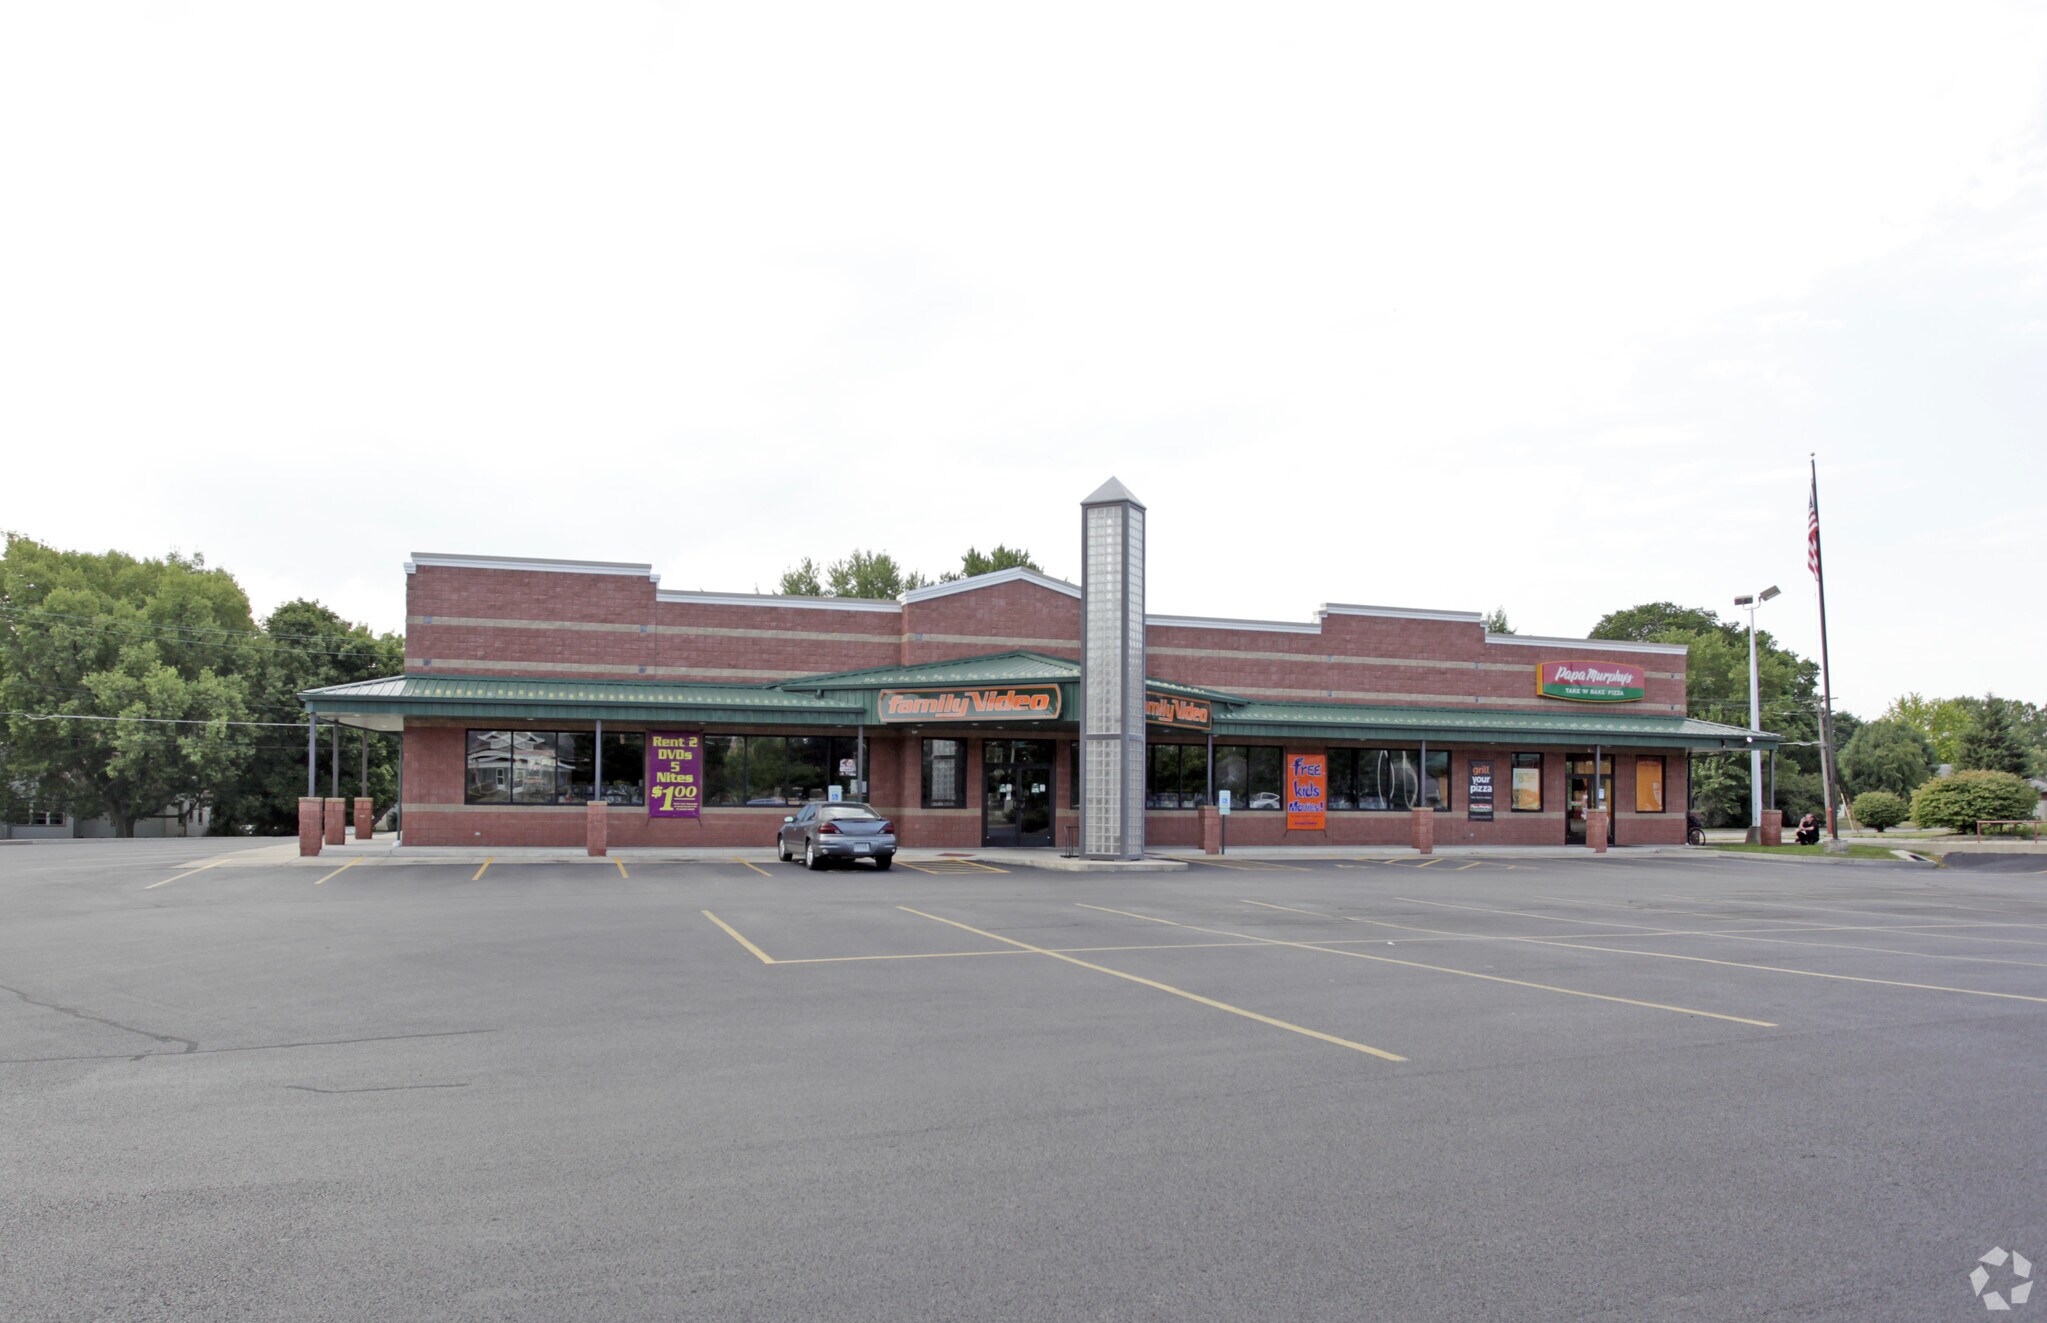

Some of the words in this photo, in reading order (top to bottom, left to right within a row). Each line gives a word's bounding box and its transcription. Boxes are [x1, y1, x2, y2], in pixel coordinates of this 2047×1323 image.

[1555, 666, 1586, 682] Papa
[1586, 668, 1633, 685] Murphy's
[888, 693, 970, 718] family
[964, 690, 1050, 712] Video
[1146, 699, 1174, 722] mily
[1171, 699, 1208, 722] Video
[653, 736, 686, 747] Rent
[688, 736, 698, 748] 2
[658, 749, 693, 760] DVDs
[670, 761, 680, 772] 5
[1472, 766, 1490, 775] grill
[656, 772, 694, 783] Nites
[1472, 776, 1491, 784] your
[1470, 783, 1492, 794] pizza
